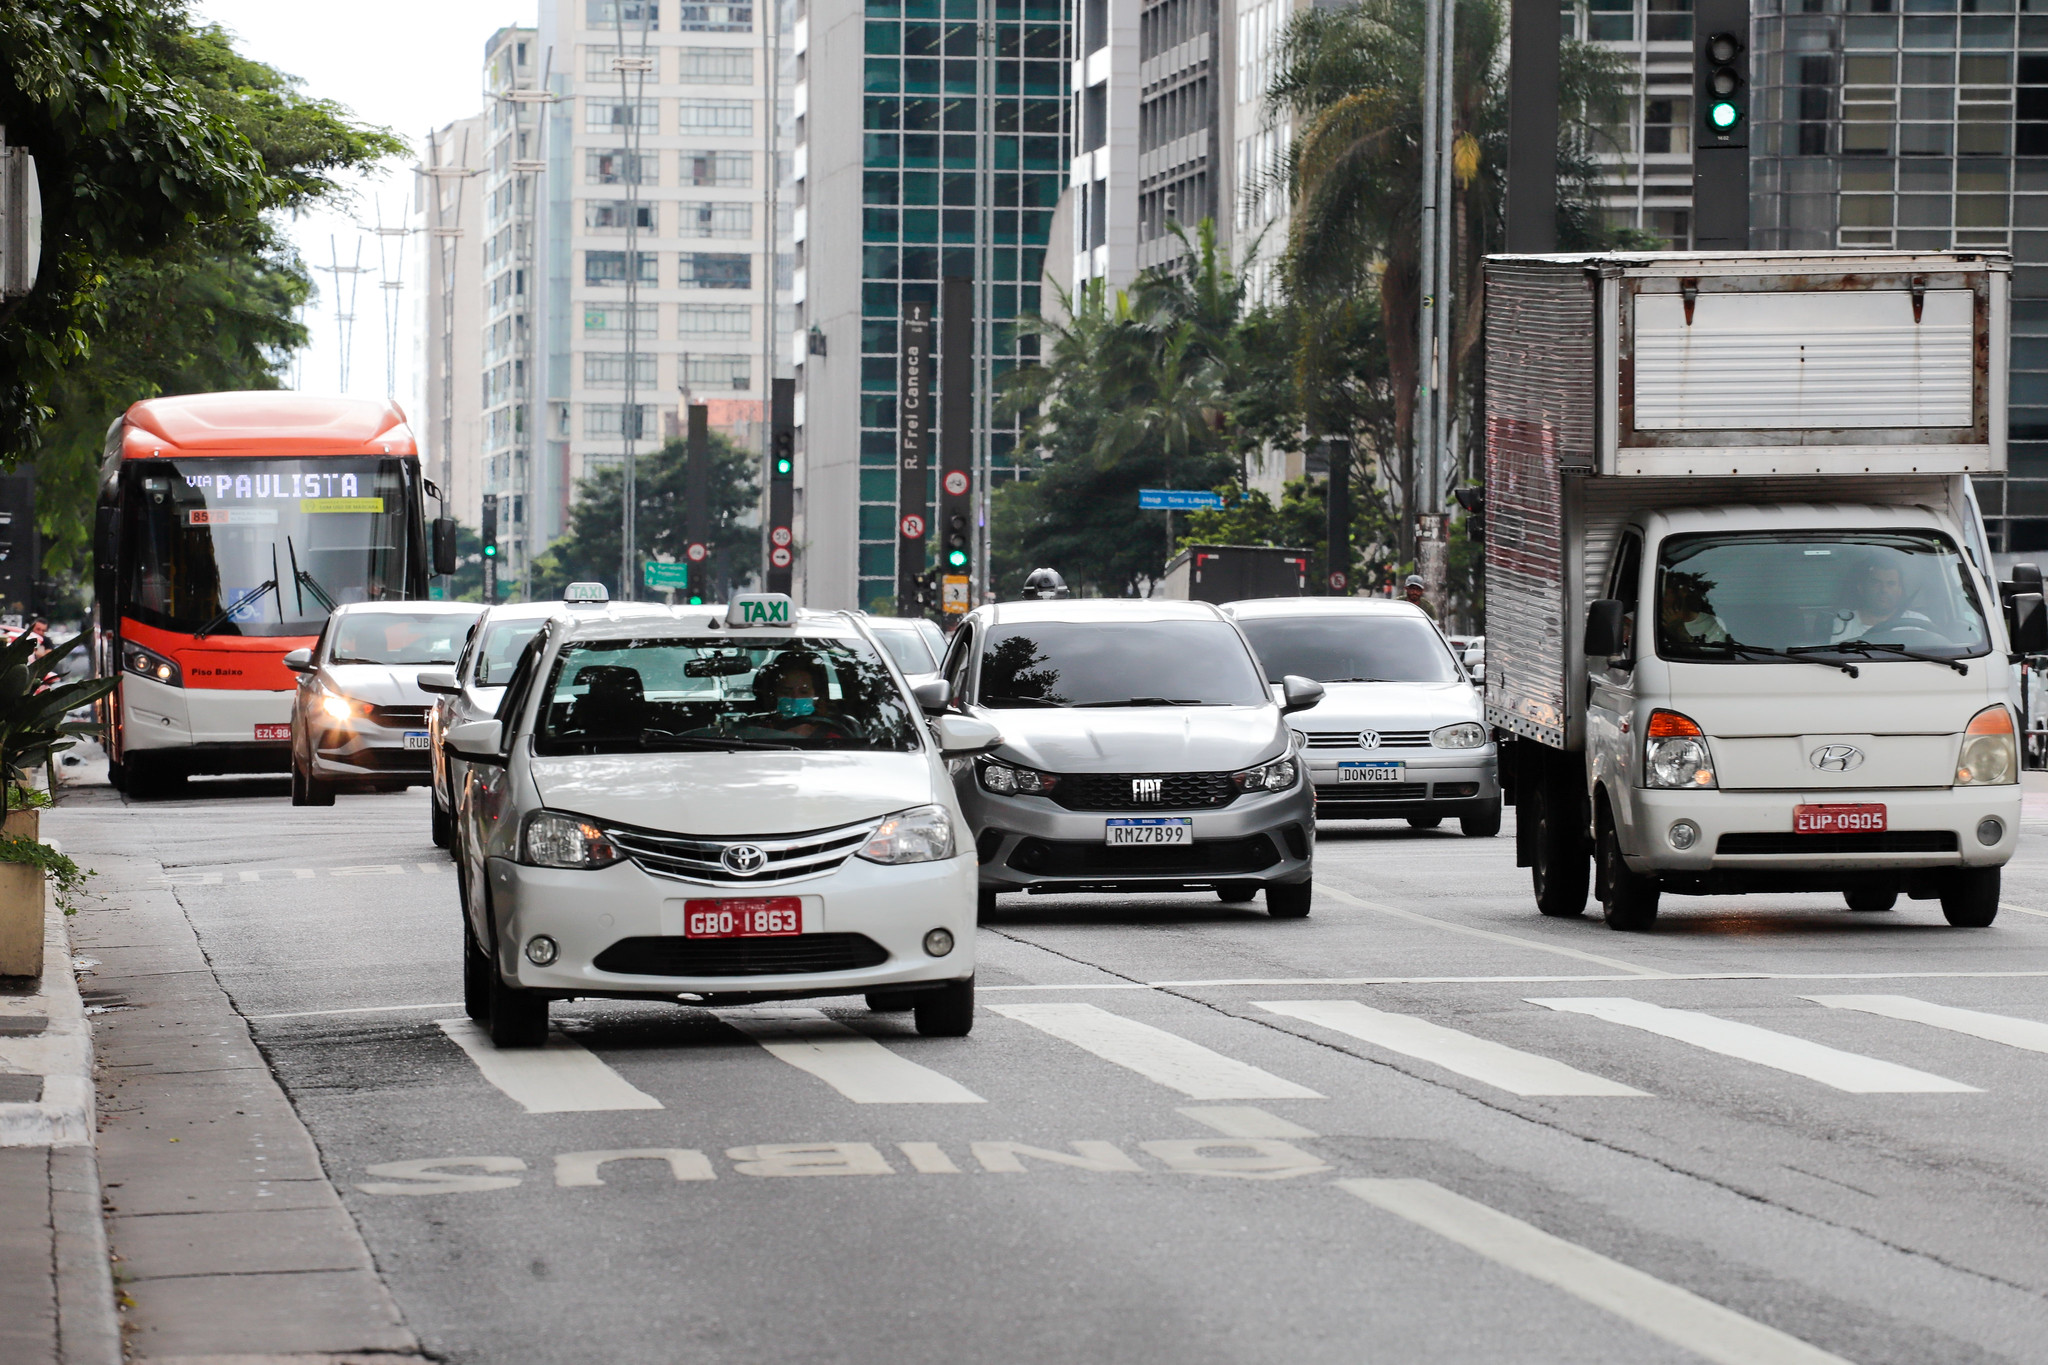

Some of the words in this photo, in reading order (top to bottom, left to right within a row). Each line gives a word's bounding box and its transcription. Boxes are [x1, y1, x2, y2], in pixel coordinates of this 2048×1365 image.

[905, 346, 919, 409] Caneca
[904, 414, 918, 449] Frei
[904, 454, 918, 469] R.
[186, 475, 212, 487] VIA
[216, 473, 358, 498] PAULISTA
[775, 531, 788, 540] 50
[571, 586, 602, 599] TAXI
[739, 601, 788, 622] TAXI
[192, 668, 212, 676] Piso
[215, 668, 243, 676] Baixo
[1132, 779, 1163, 801] FIAT
[1115, 827, 1184, 843] RMZ7B99
